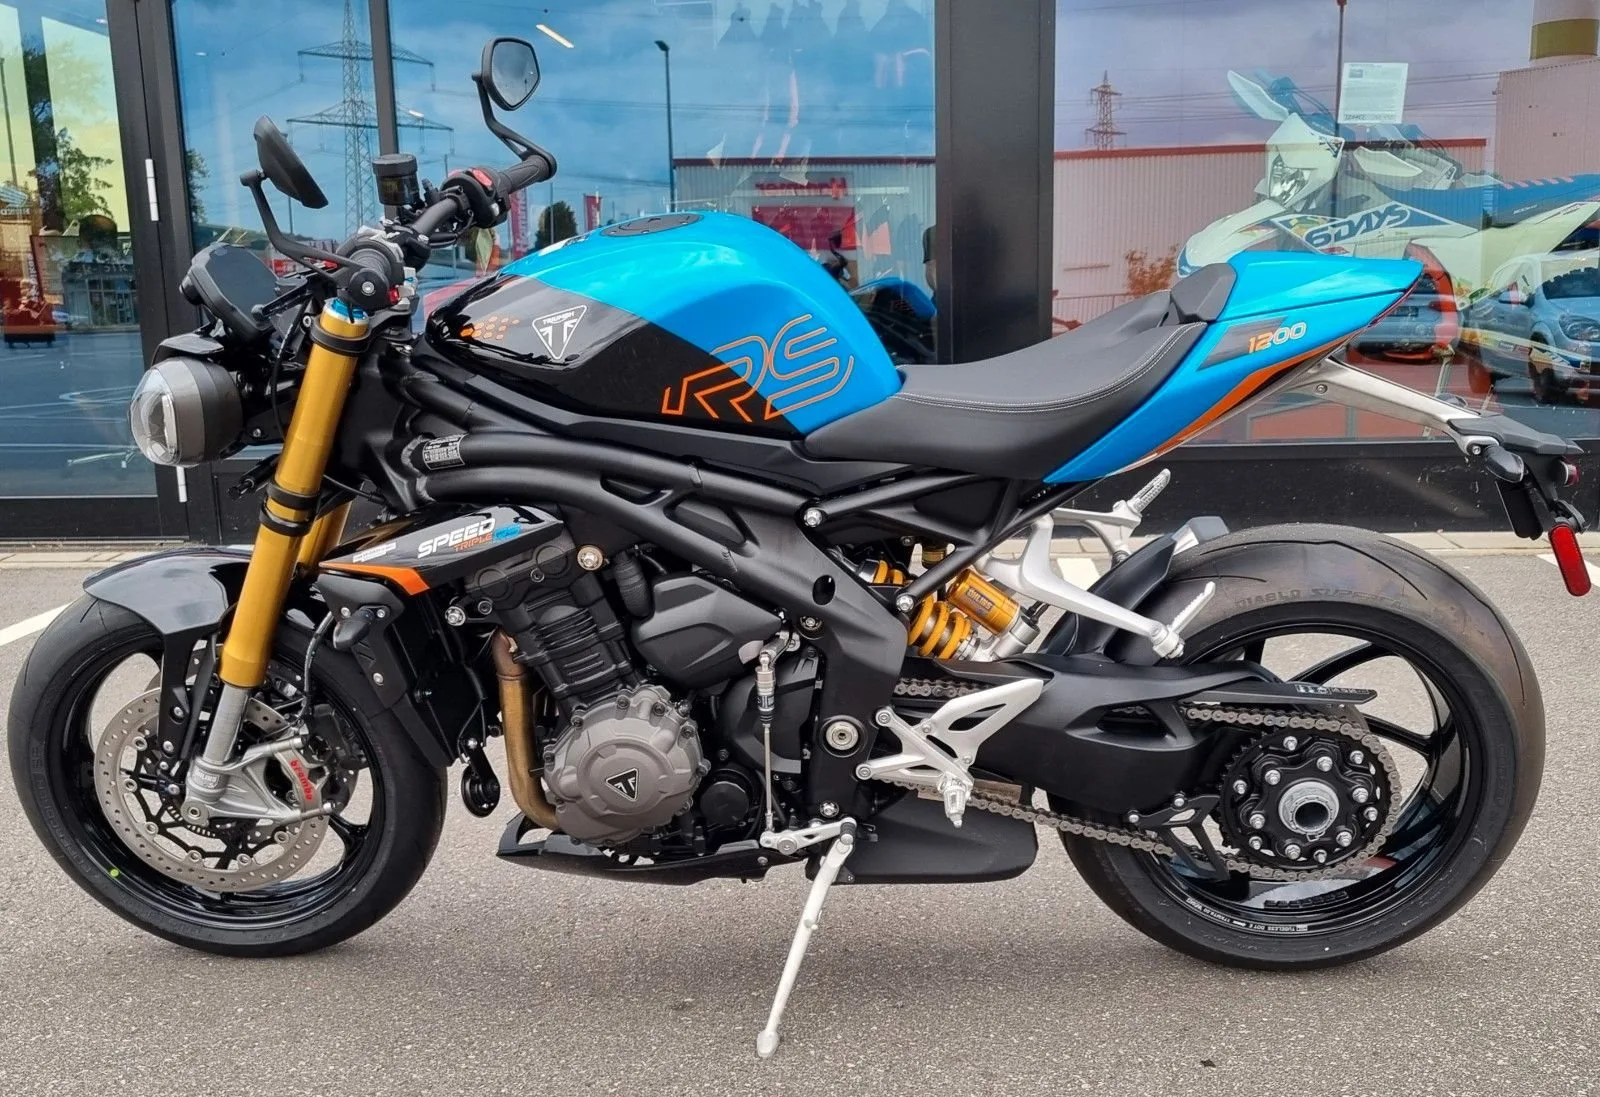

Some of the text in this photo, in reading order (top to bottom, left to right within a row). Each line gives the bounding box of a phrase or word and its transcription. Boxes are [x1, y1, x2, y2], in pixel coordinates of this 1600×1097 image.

[1304, 203, 1408, 248] 6DAYS
[1249, 321, 1307, 354] 1200
[661, 313, 855, 423] RS
[417, 517, 496, 559] SPEED
[454, 532, 493, 552] TRIPLE
[290, 759, 313, 801] brembo
